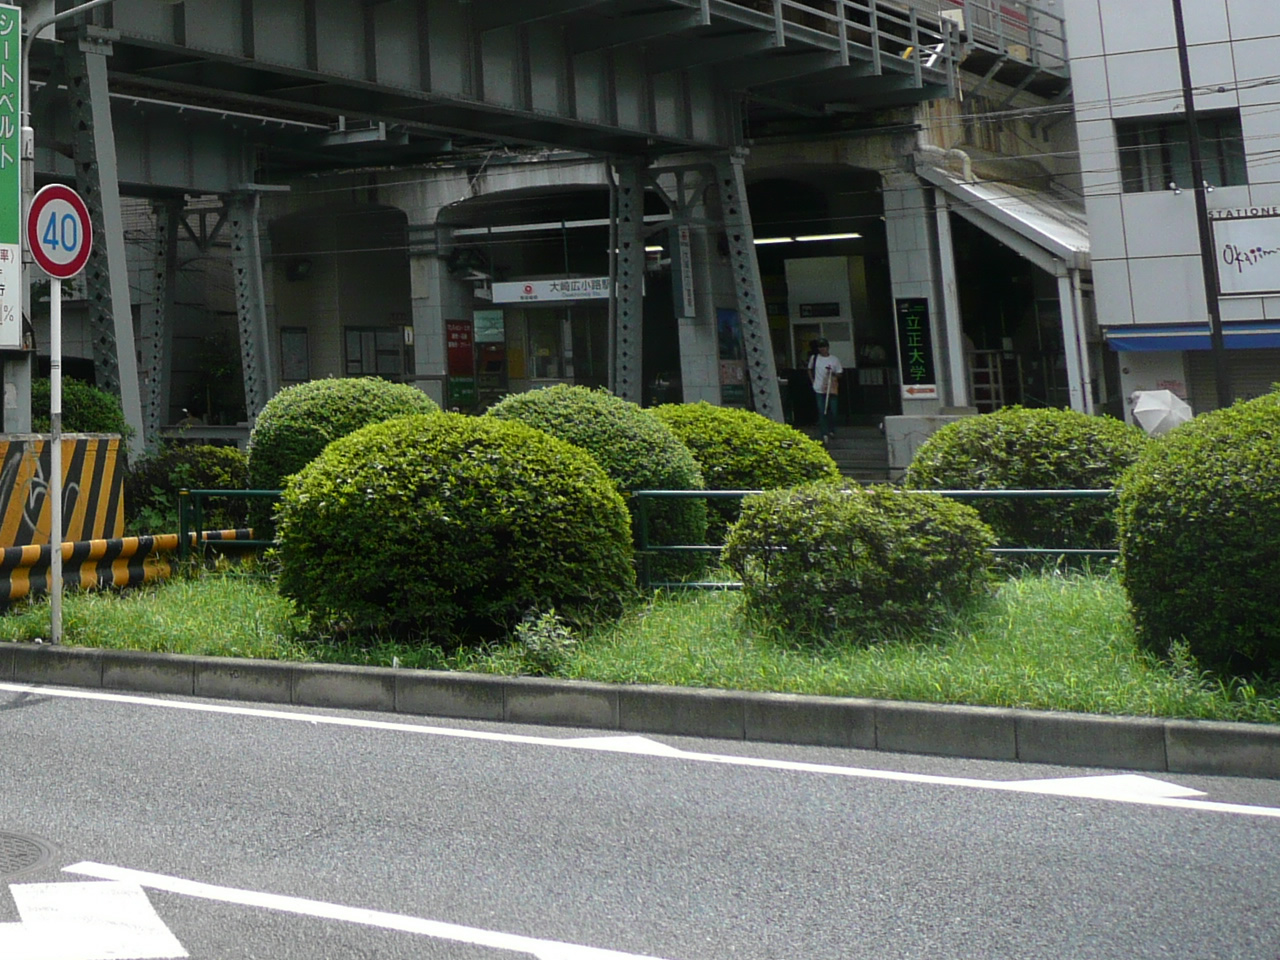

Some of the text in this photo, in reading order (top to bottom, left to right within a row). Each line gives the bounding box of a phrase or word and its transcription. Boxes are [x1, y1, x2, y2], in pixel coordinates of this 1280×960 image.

[42, 210, 79, 254] 40
[905, 314, 927, 381] 立正大学
